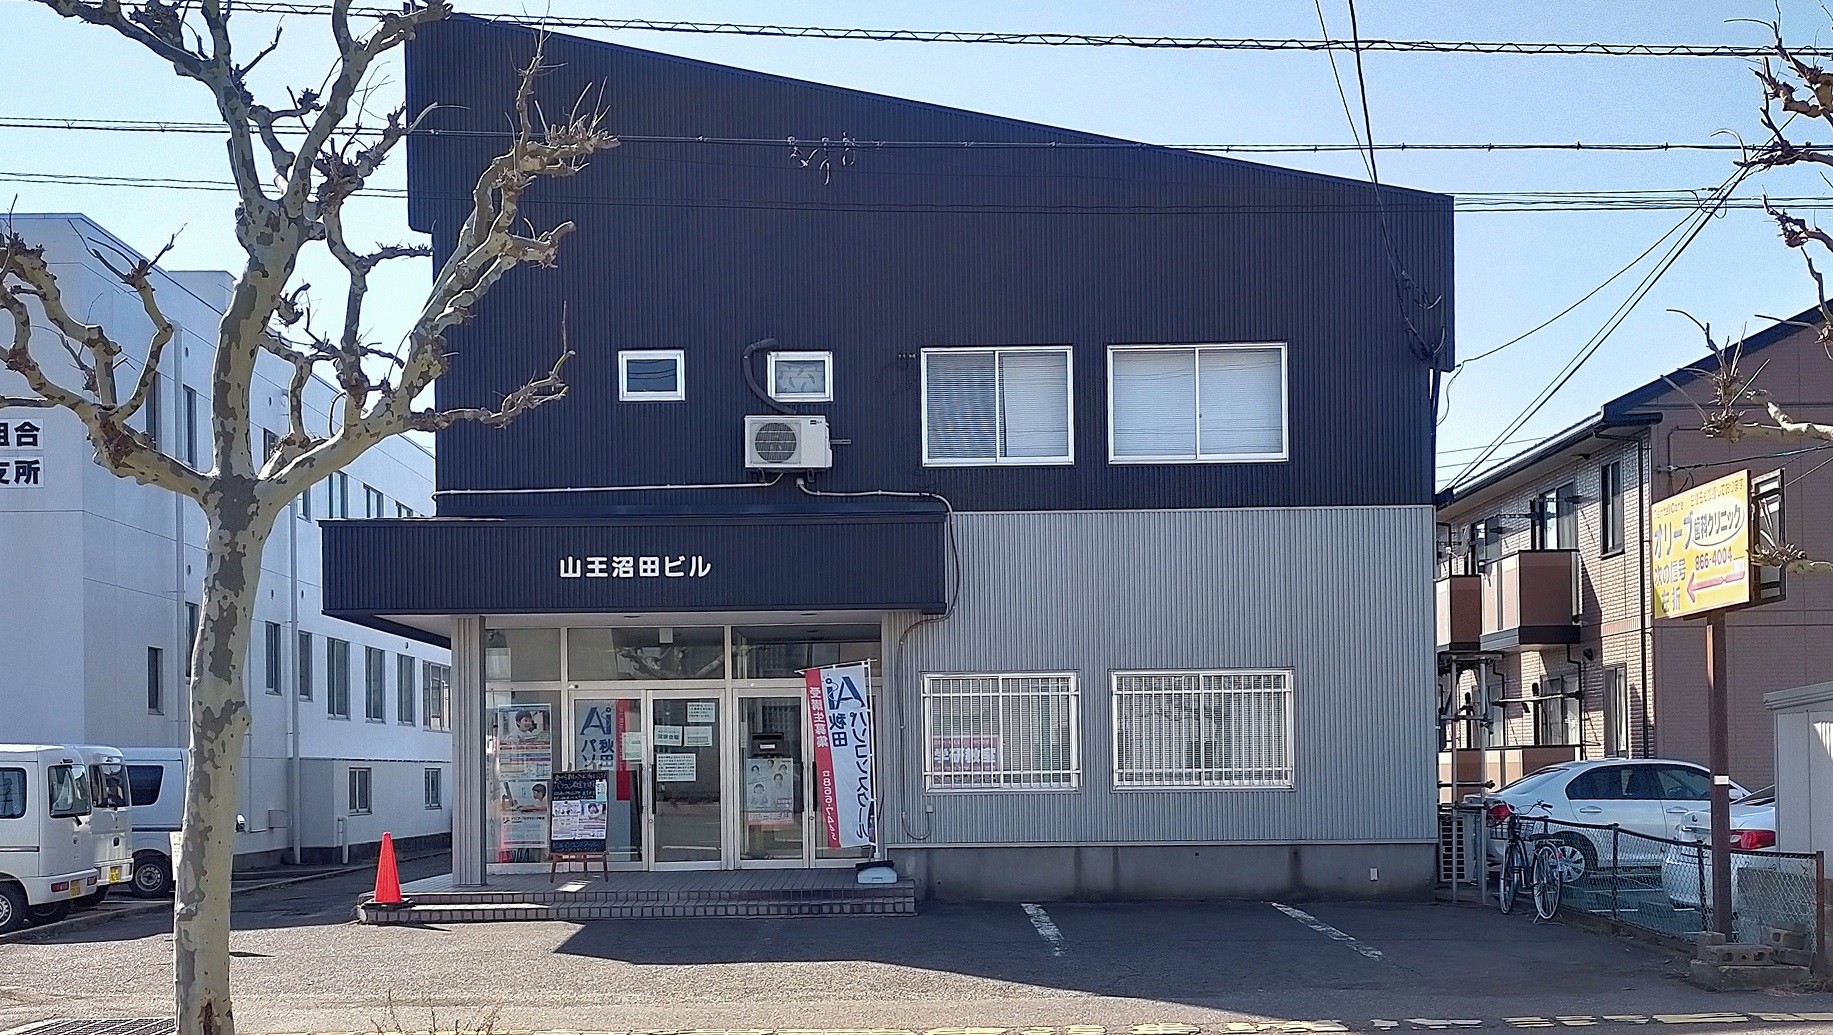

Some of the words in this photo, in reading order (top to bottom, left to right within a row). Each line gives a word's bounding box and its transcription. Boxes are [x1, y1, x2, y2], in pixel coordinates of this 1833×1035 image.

[1694, 504, 1741, 541] 歯科クリニック
[559, 555, 712, 578] 山王沼田ビル
[1654, 558, 1686, 587] 次の信号
[1661, 585, 1681, 614] 左折
[599, 738, 615, 768] 秋田
